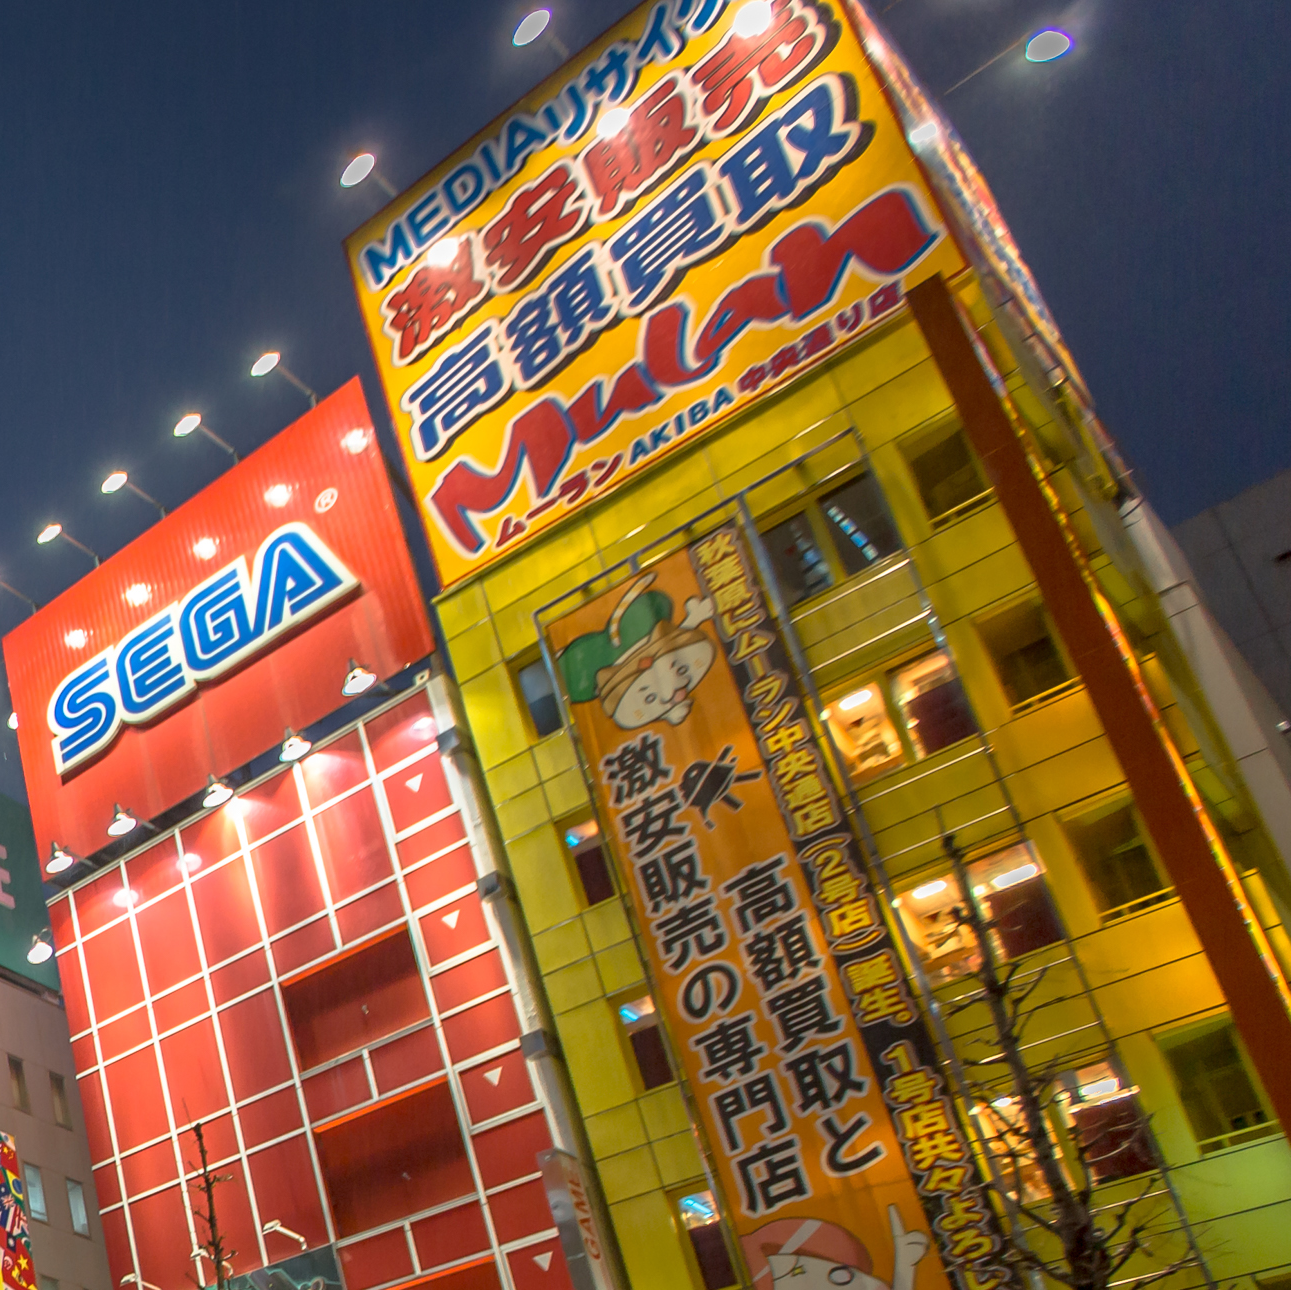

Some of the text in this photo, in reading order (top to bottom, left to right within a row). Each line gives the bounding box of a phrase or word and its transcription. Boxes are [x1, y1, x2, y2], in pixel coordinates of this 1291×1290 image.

[403, 74, 863, 460] 高額買取
[495, 281, 904, 549] ムーラン AKIBA 中央通り店
[47, 522, 360, 775] SEGA
[601, 730, 809, 1217] 激安販売の専門店
[722, 854, 886, 1177] 高額買取と
